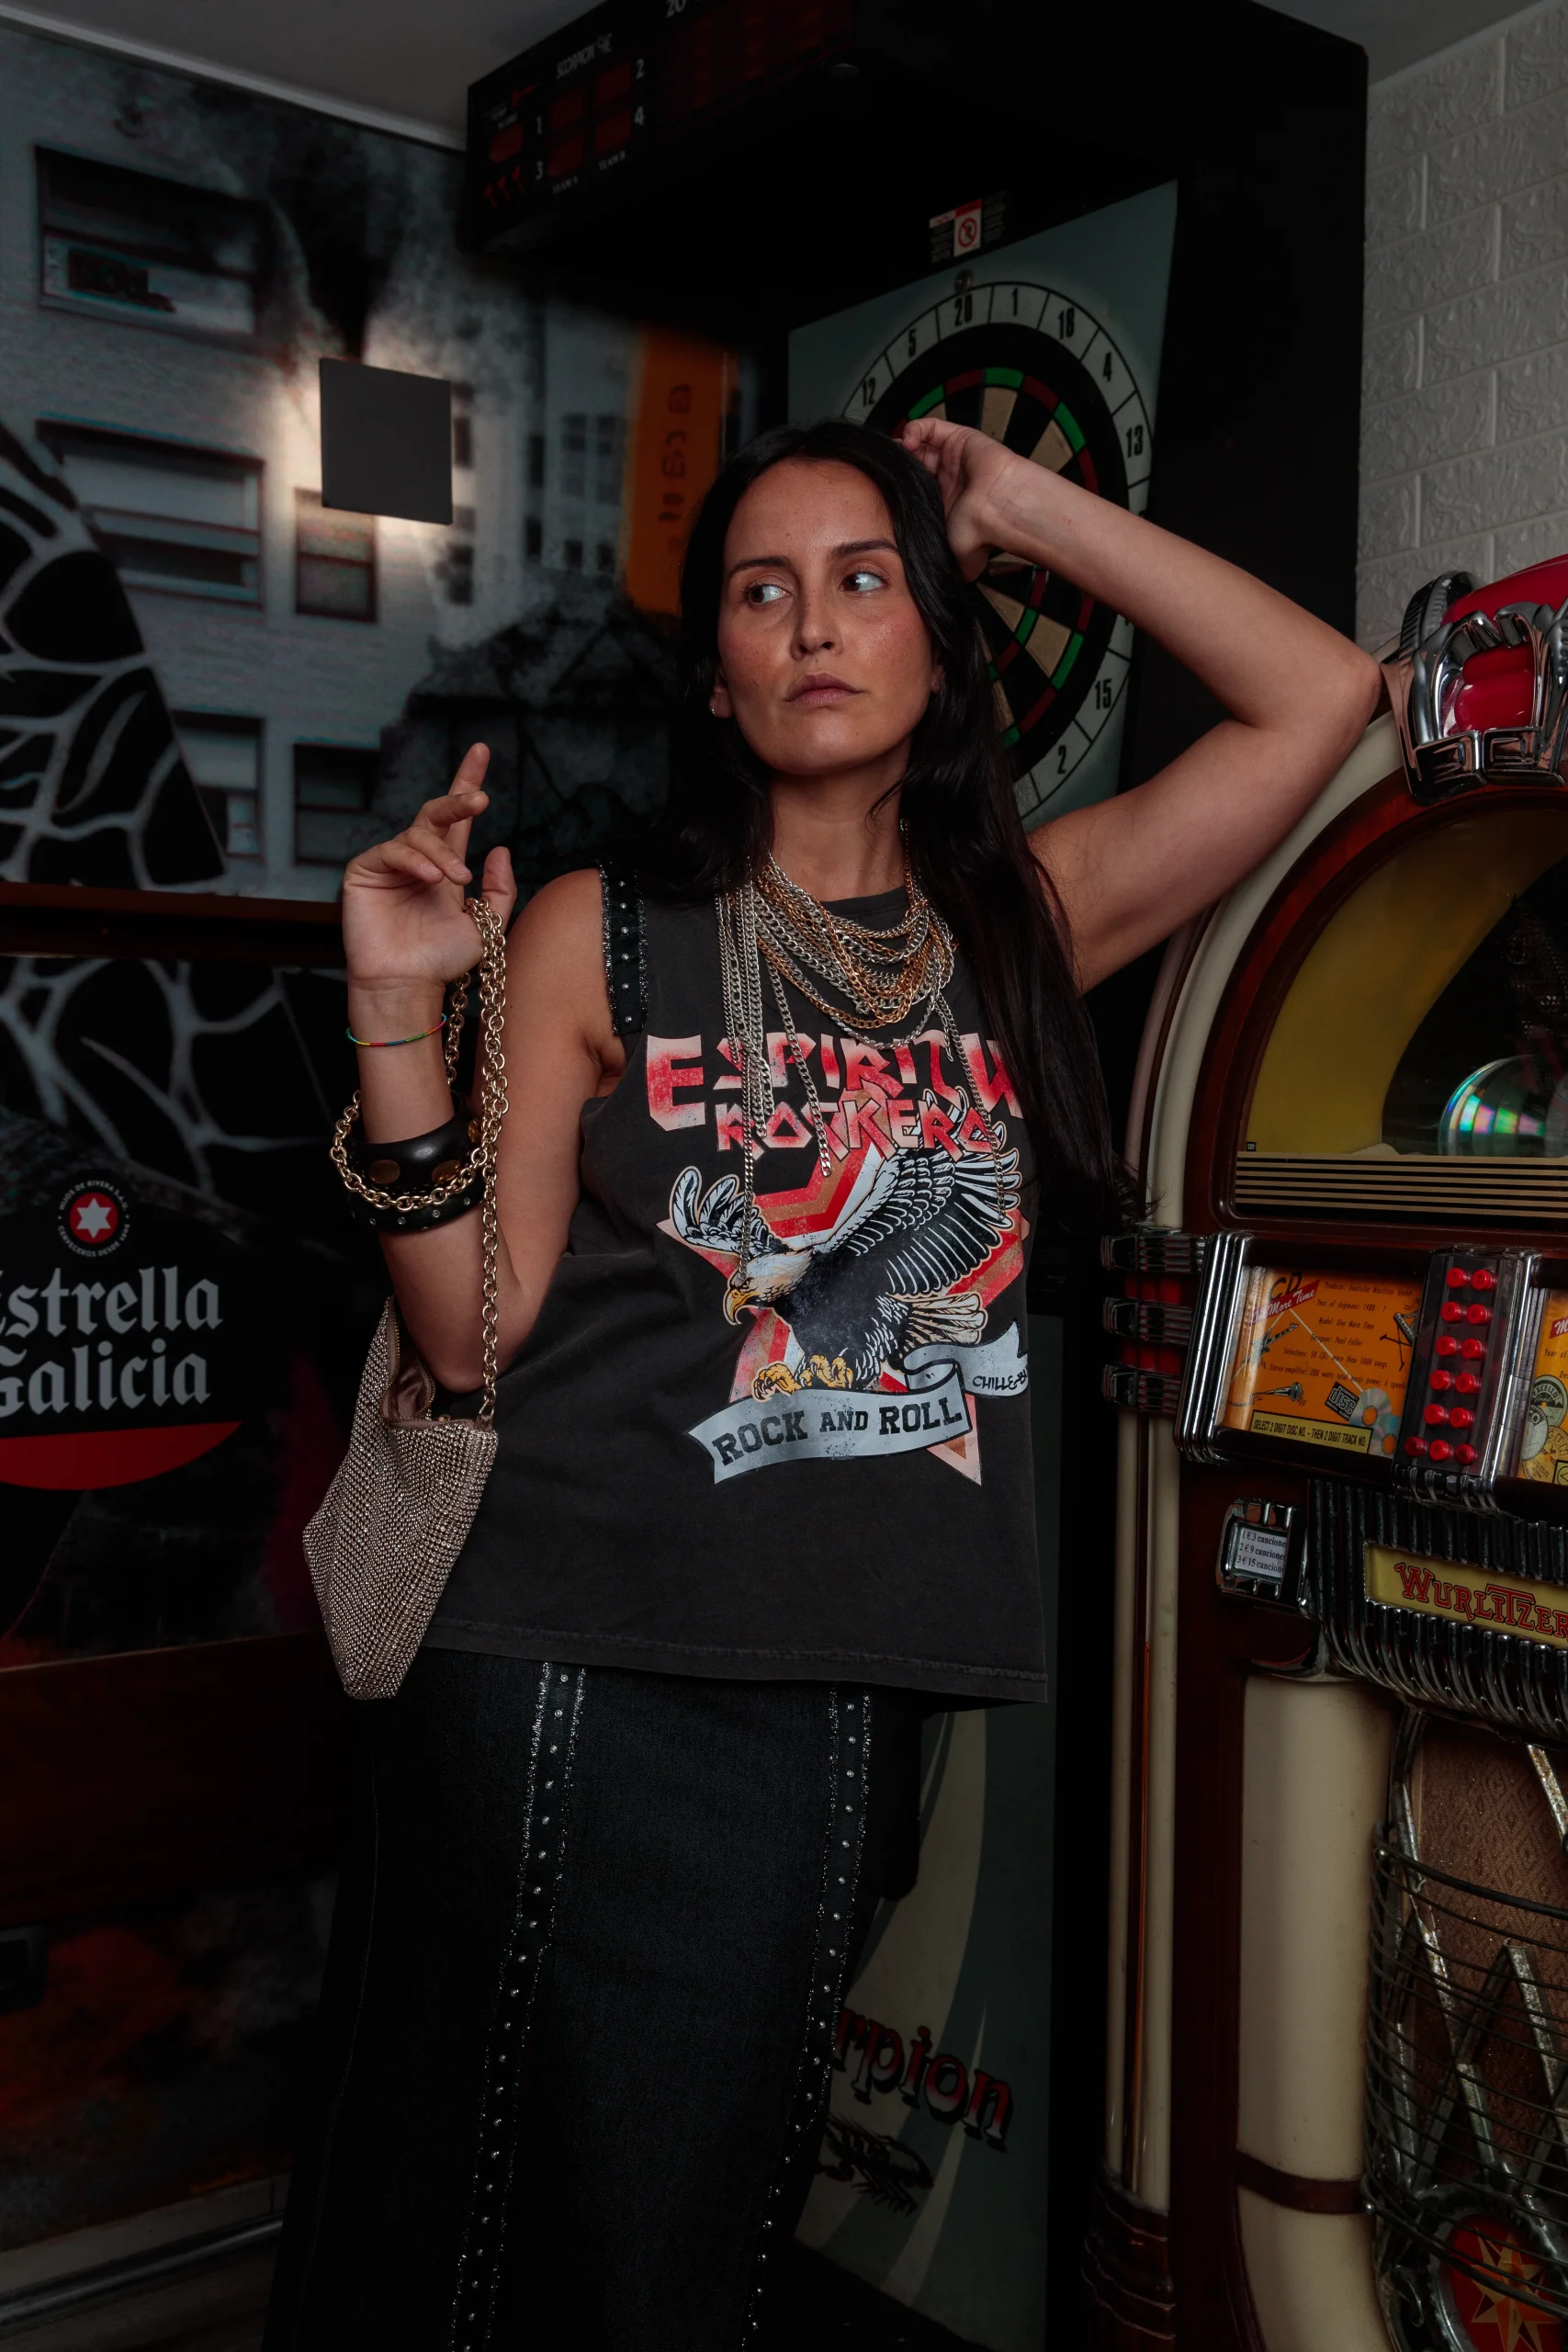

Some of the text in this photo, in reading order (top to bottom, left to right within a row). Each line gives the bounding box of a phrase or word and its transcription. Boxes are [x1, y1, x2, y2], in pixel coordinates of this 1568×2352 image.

[634, 106, 645, 126] 4
[953, 294, 973, 327] 20
[1011, 288, 1019, 317] 1
[1058, 308, 1075, 340] 18
[908, 331, 917, 357] 5
[1102, 352, 1112, 383] 4
[863, 378, 876, 406] 12
[1126, 424, 1144, 458] 13
[1094, 679, 1112, 710] 15
[1057, 745, 1066, 775] 2
[86, 1180, 115, 1193] RIVERA
[1269, 1272, 1303, 1301] CD
[1268, 1299, 1293, 1317] More
[1292, 1288, 1315, 1305] Time
[1317, 1298, 1327, 1307] Year
[1337, 1318, 1347, 1328] One
[1348, 1319, 1360, 1329] More
[1362, 1321, 1375, 1330] Time
[1335, 1336, 1346, 1344] Paul
[1544, 1349, 1557, 1357] Year
[1328, 1385, 1357, 1415] disc
[711, 1396, 963, 1467] ROCK AND ROLL
[1253, 1419, 1269, 1430] SELECT
[1273, 1424, 1287, 1434] DIGIT
[1286, 1424, 1298, 1436] DISC
[1297, 1426, 1306, 1438] NO.
[1311, 1428, 1324, 1440] THEN
[1327, 1432, 1342, 1443] DIGIT
[1342, 1432, 1359, 1445] TRACK
[1358, 1436, 1366, 1446] NO.
[1257, 1536, 1287, 1548] cancione
[1248, 1557, 1256, 1566] 15
